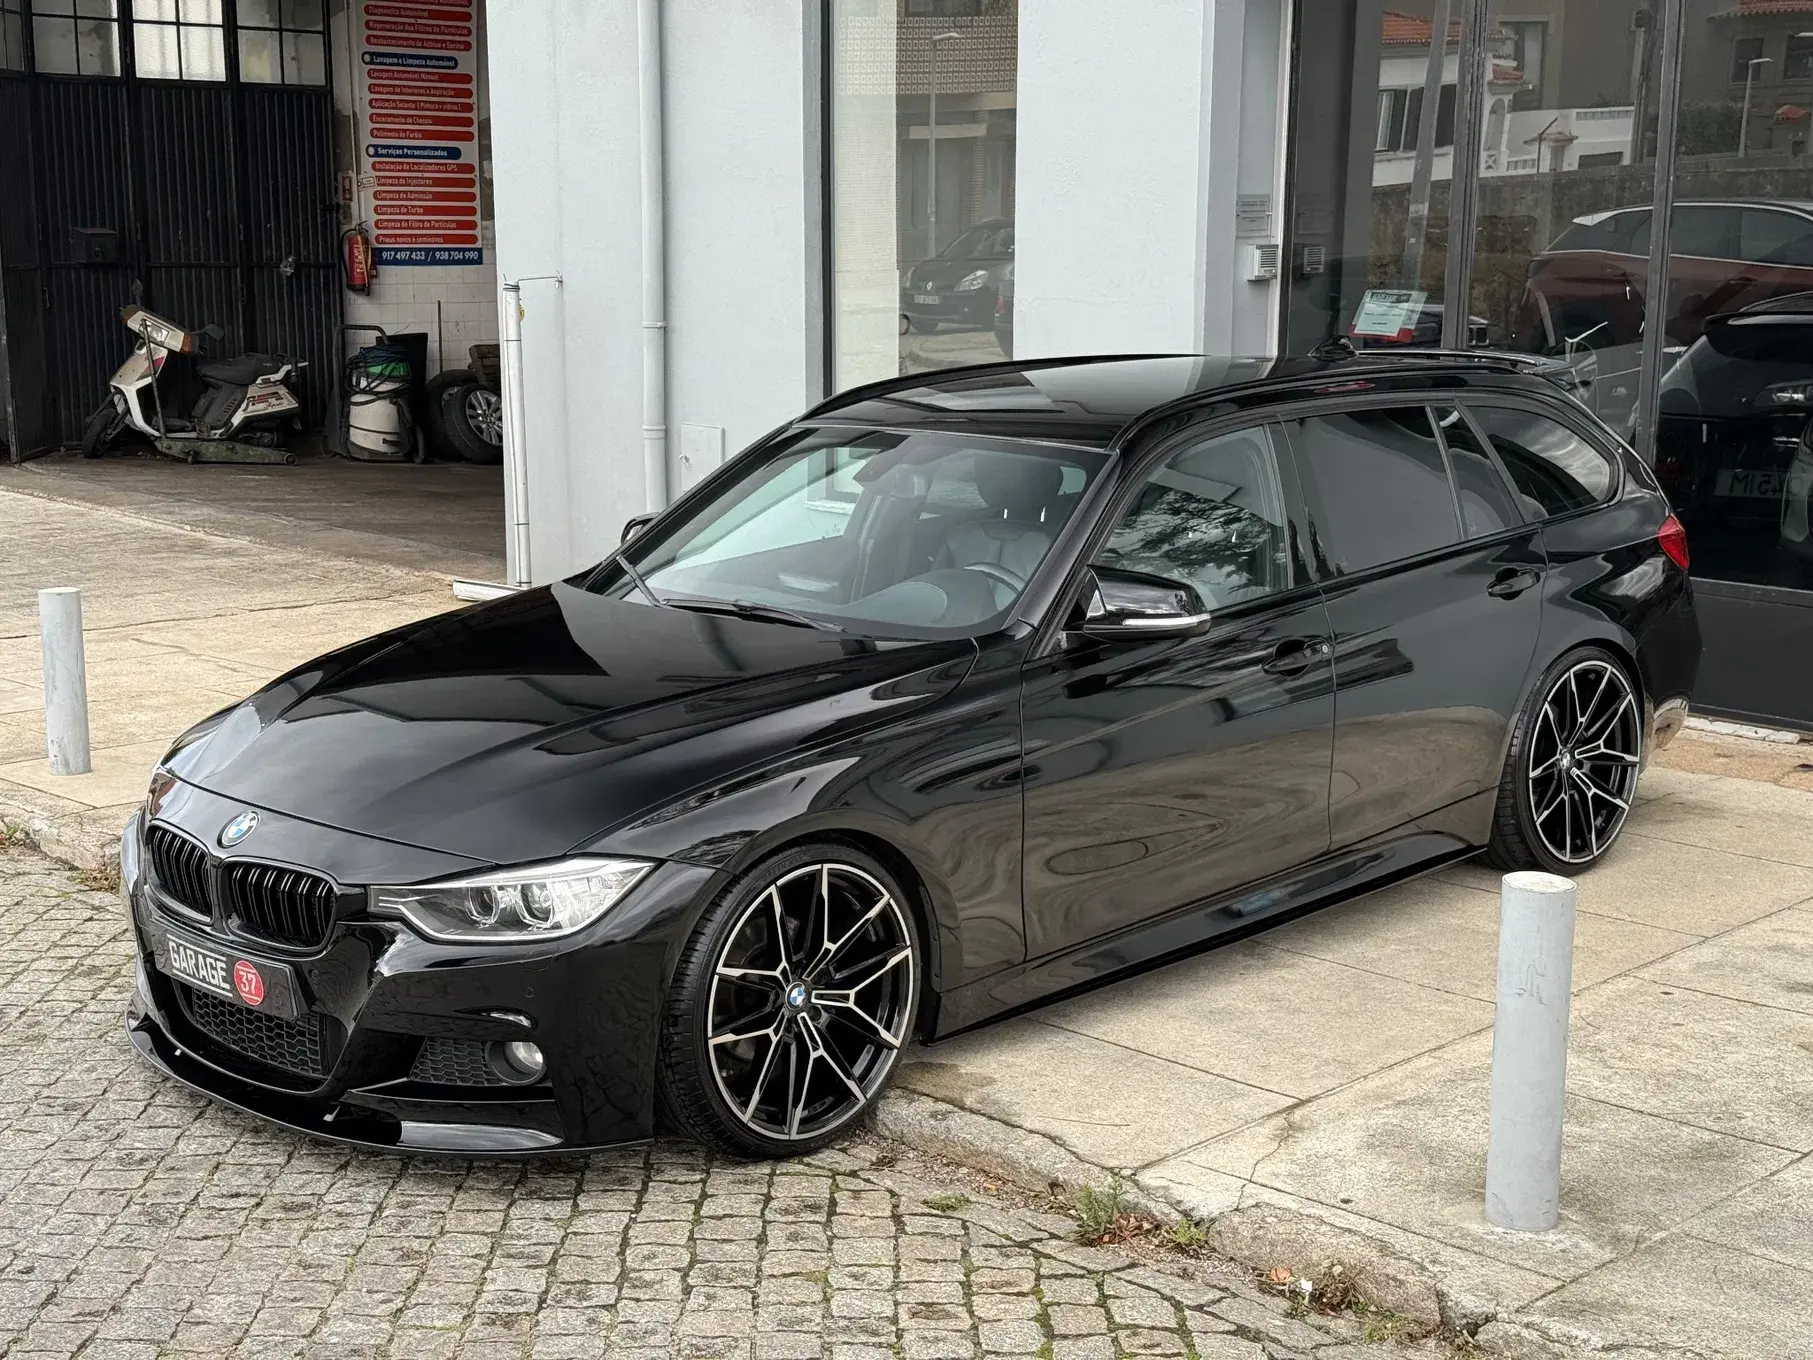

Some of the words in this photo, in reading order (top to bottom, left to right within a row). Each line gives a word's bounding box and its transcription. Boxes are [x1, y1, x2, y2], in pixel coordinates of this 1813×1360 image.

[374, 56, 398, 64] Lavagem
[403, 57, 425, 66] Limpeza
[376, 163, 402, 171] Instalação
[377, 177, 398, 185] Limpeza
[382, 252, 393, 260] 917
[428, 251, 432, 261] /
[465, 252, 478, 260] 990
[169, 940, 230, 990] GARAGE
[239, 970, 256, 994] 37
